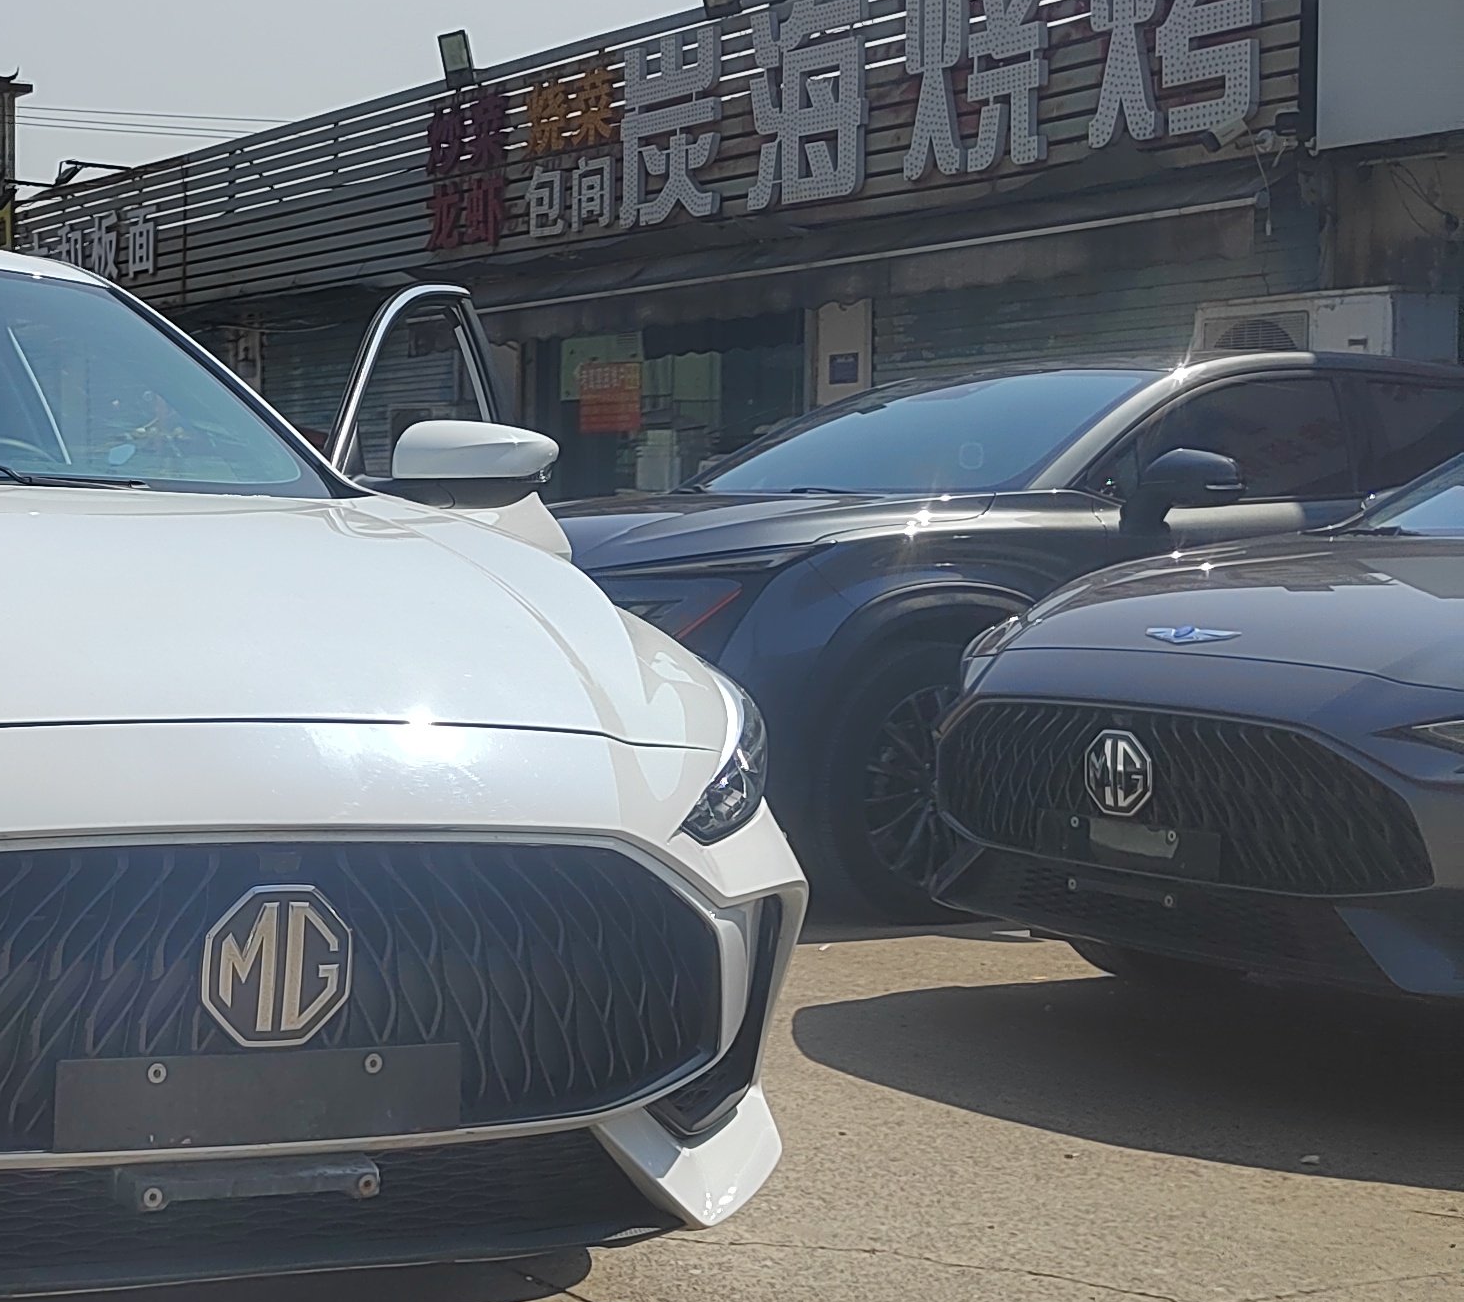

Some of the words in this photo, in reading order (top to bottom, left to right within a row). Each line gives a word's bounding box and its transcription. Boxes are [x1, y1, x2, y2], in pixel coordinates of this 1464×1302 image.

[427, 91, 508, 173] 炒菜
[524, 68, 615, 156] 烧菜
[426, 177, 505, 251] 龙虾
[525, 156, 615, 237] 包间
[1089, 738, 1144, 807] MG
[218, 901, 340, 1032] MG
